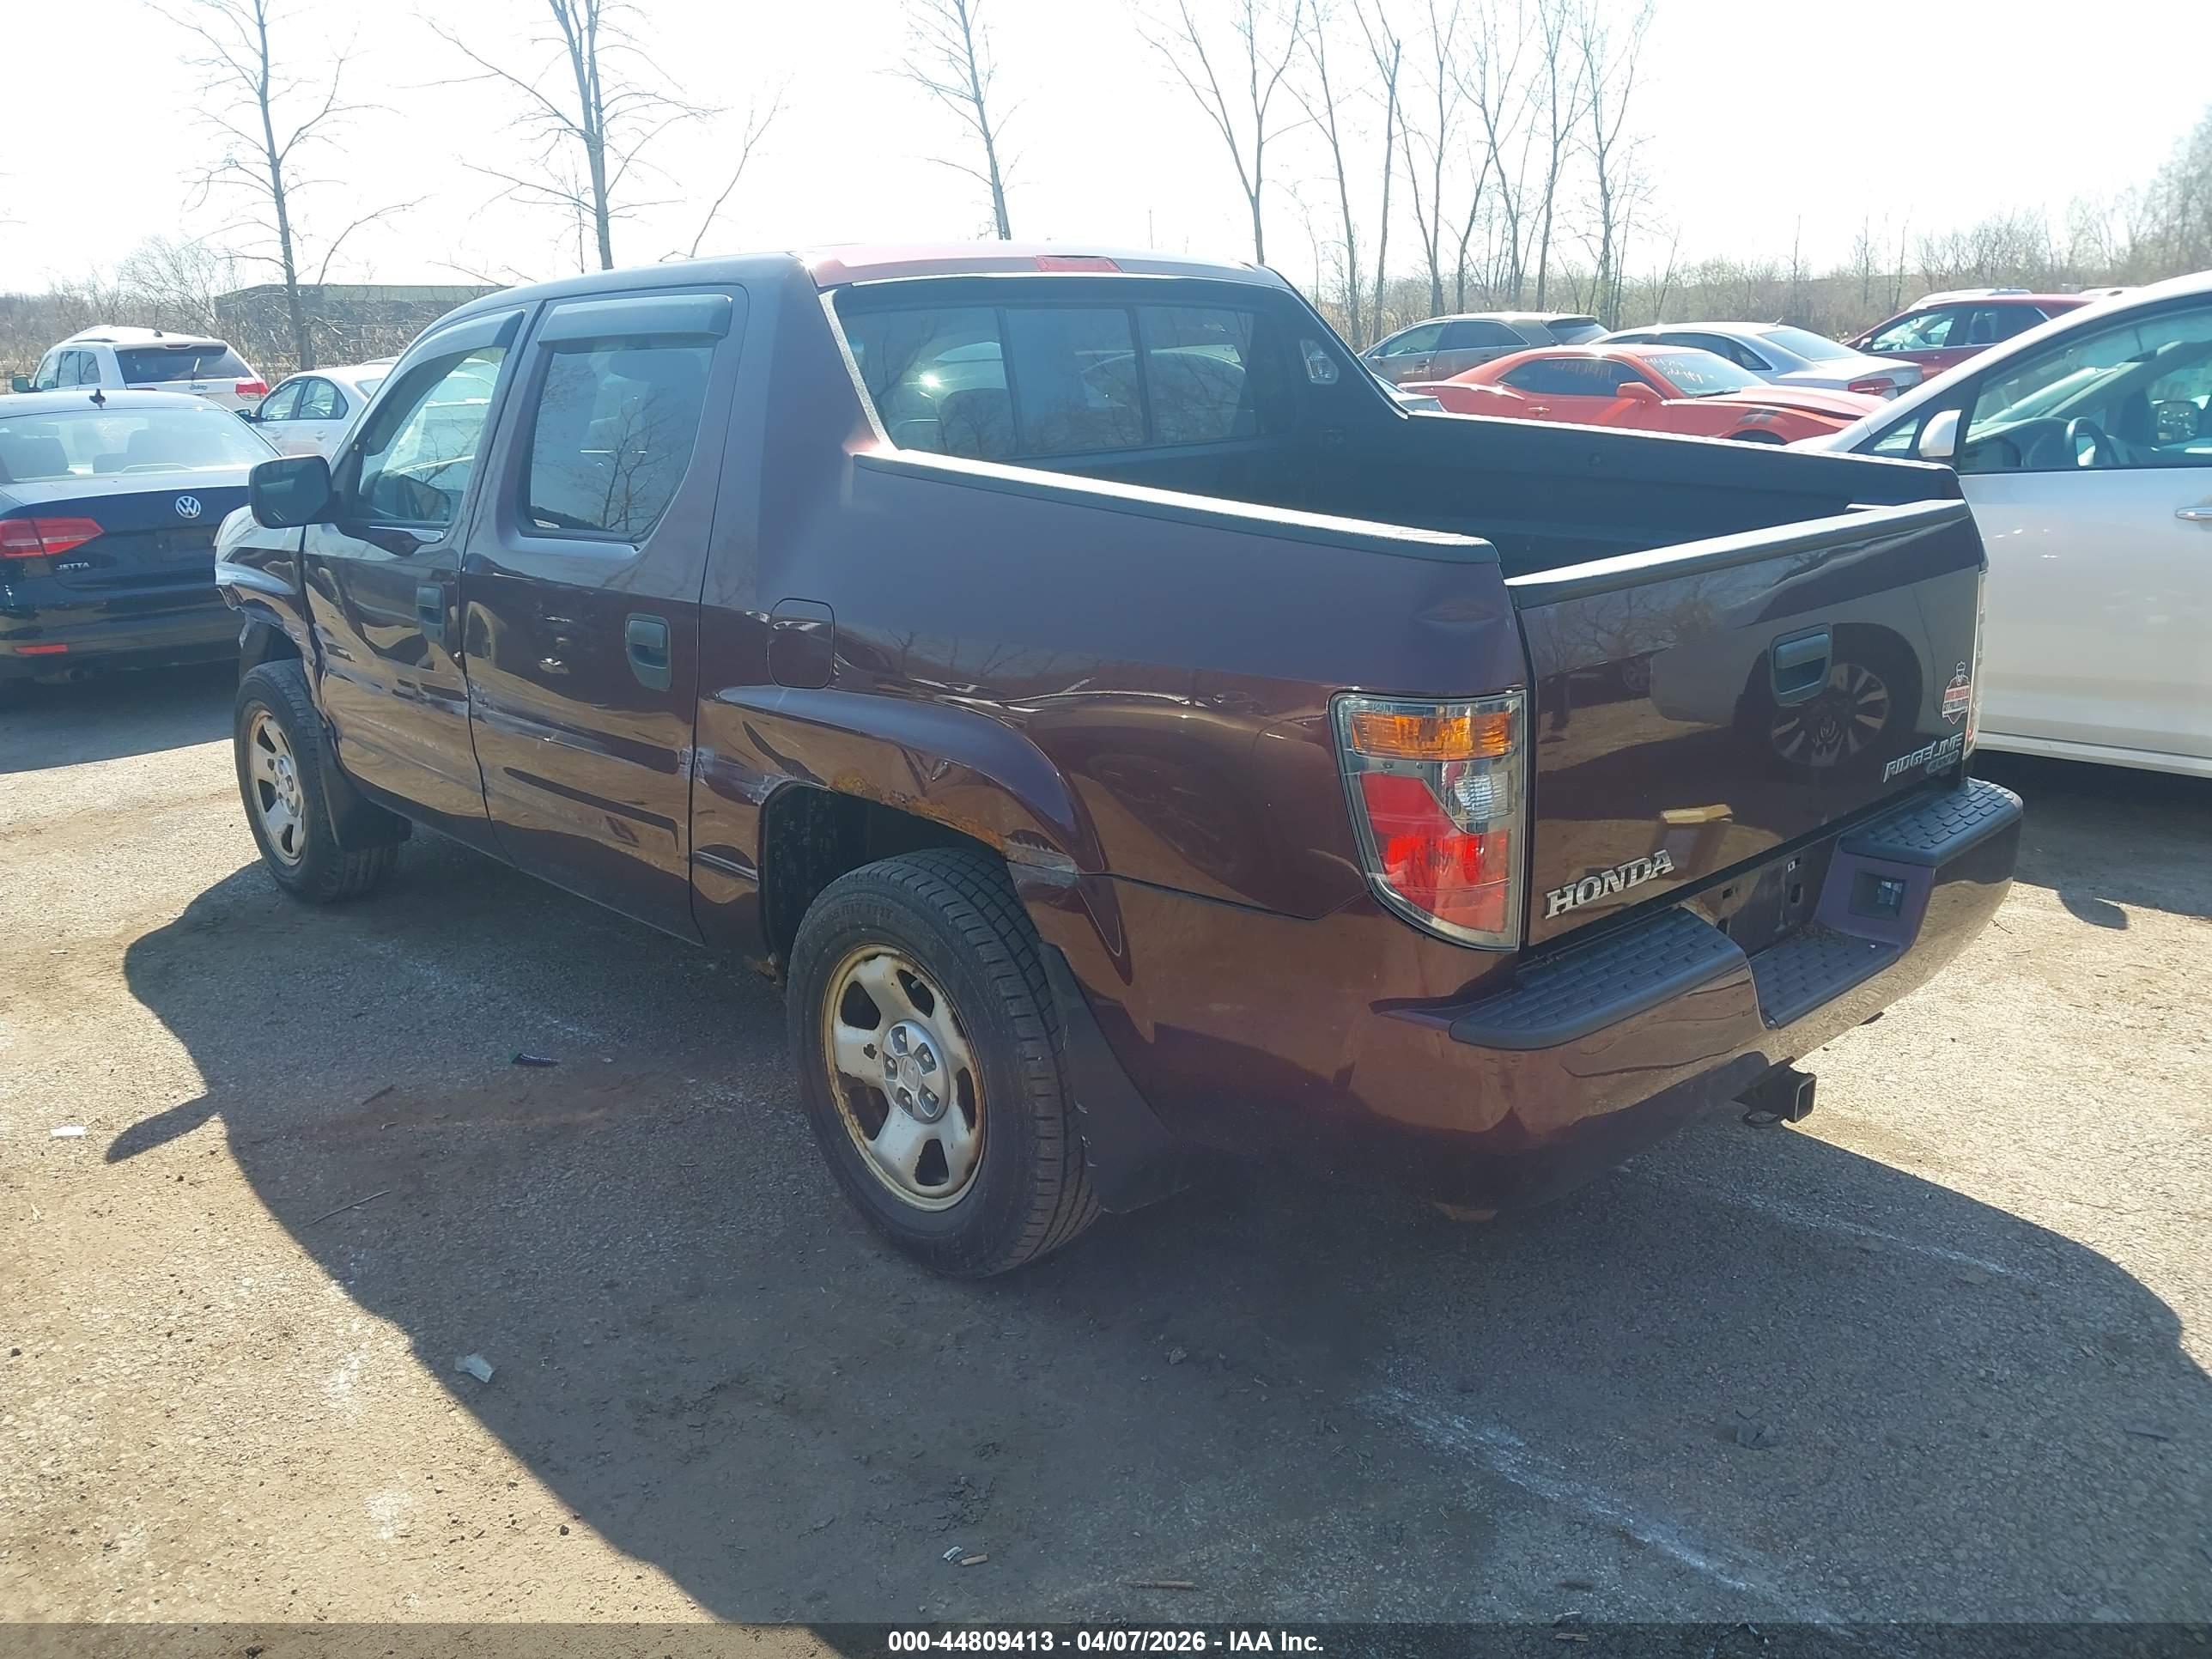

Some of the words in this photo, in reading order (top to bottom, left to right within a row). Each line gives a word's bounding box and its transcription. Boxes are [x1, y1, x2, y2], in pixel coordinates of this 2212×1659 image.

[55, 562, 90, 570] JETTA
[1883, 732, 1964, 783] RIDGELINE
[1545, 848, 1674, 920] HONDA
